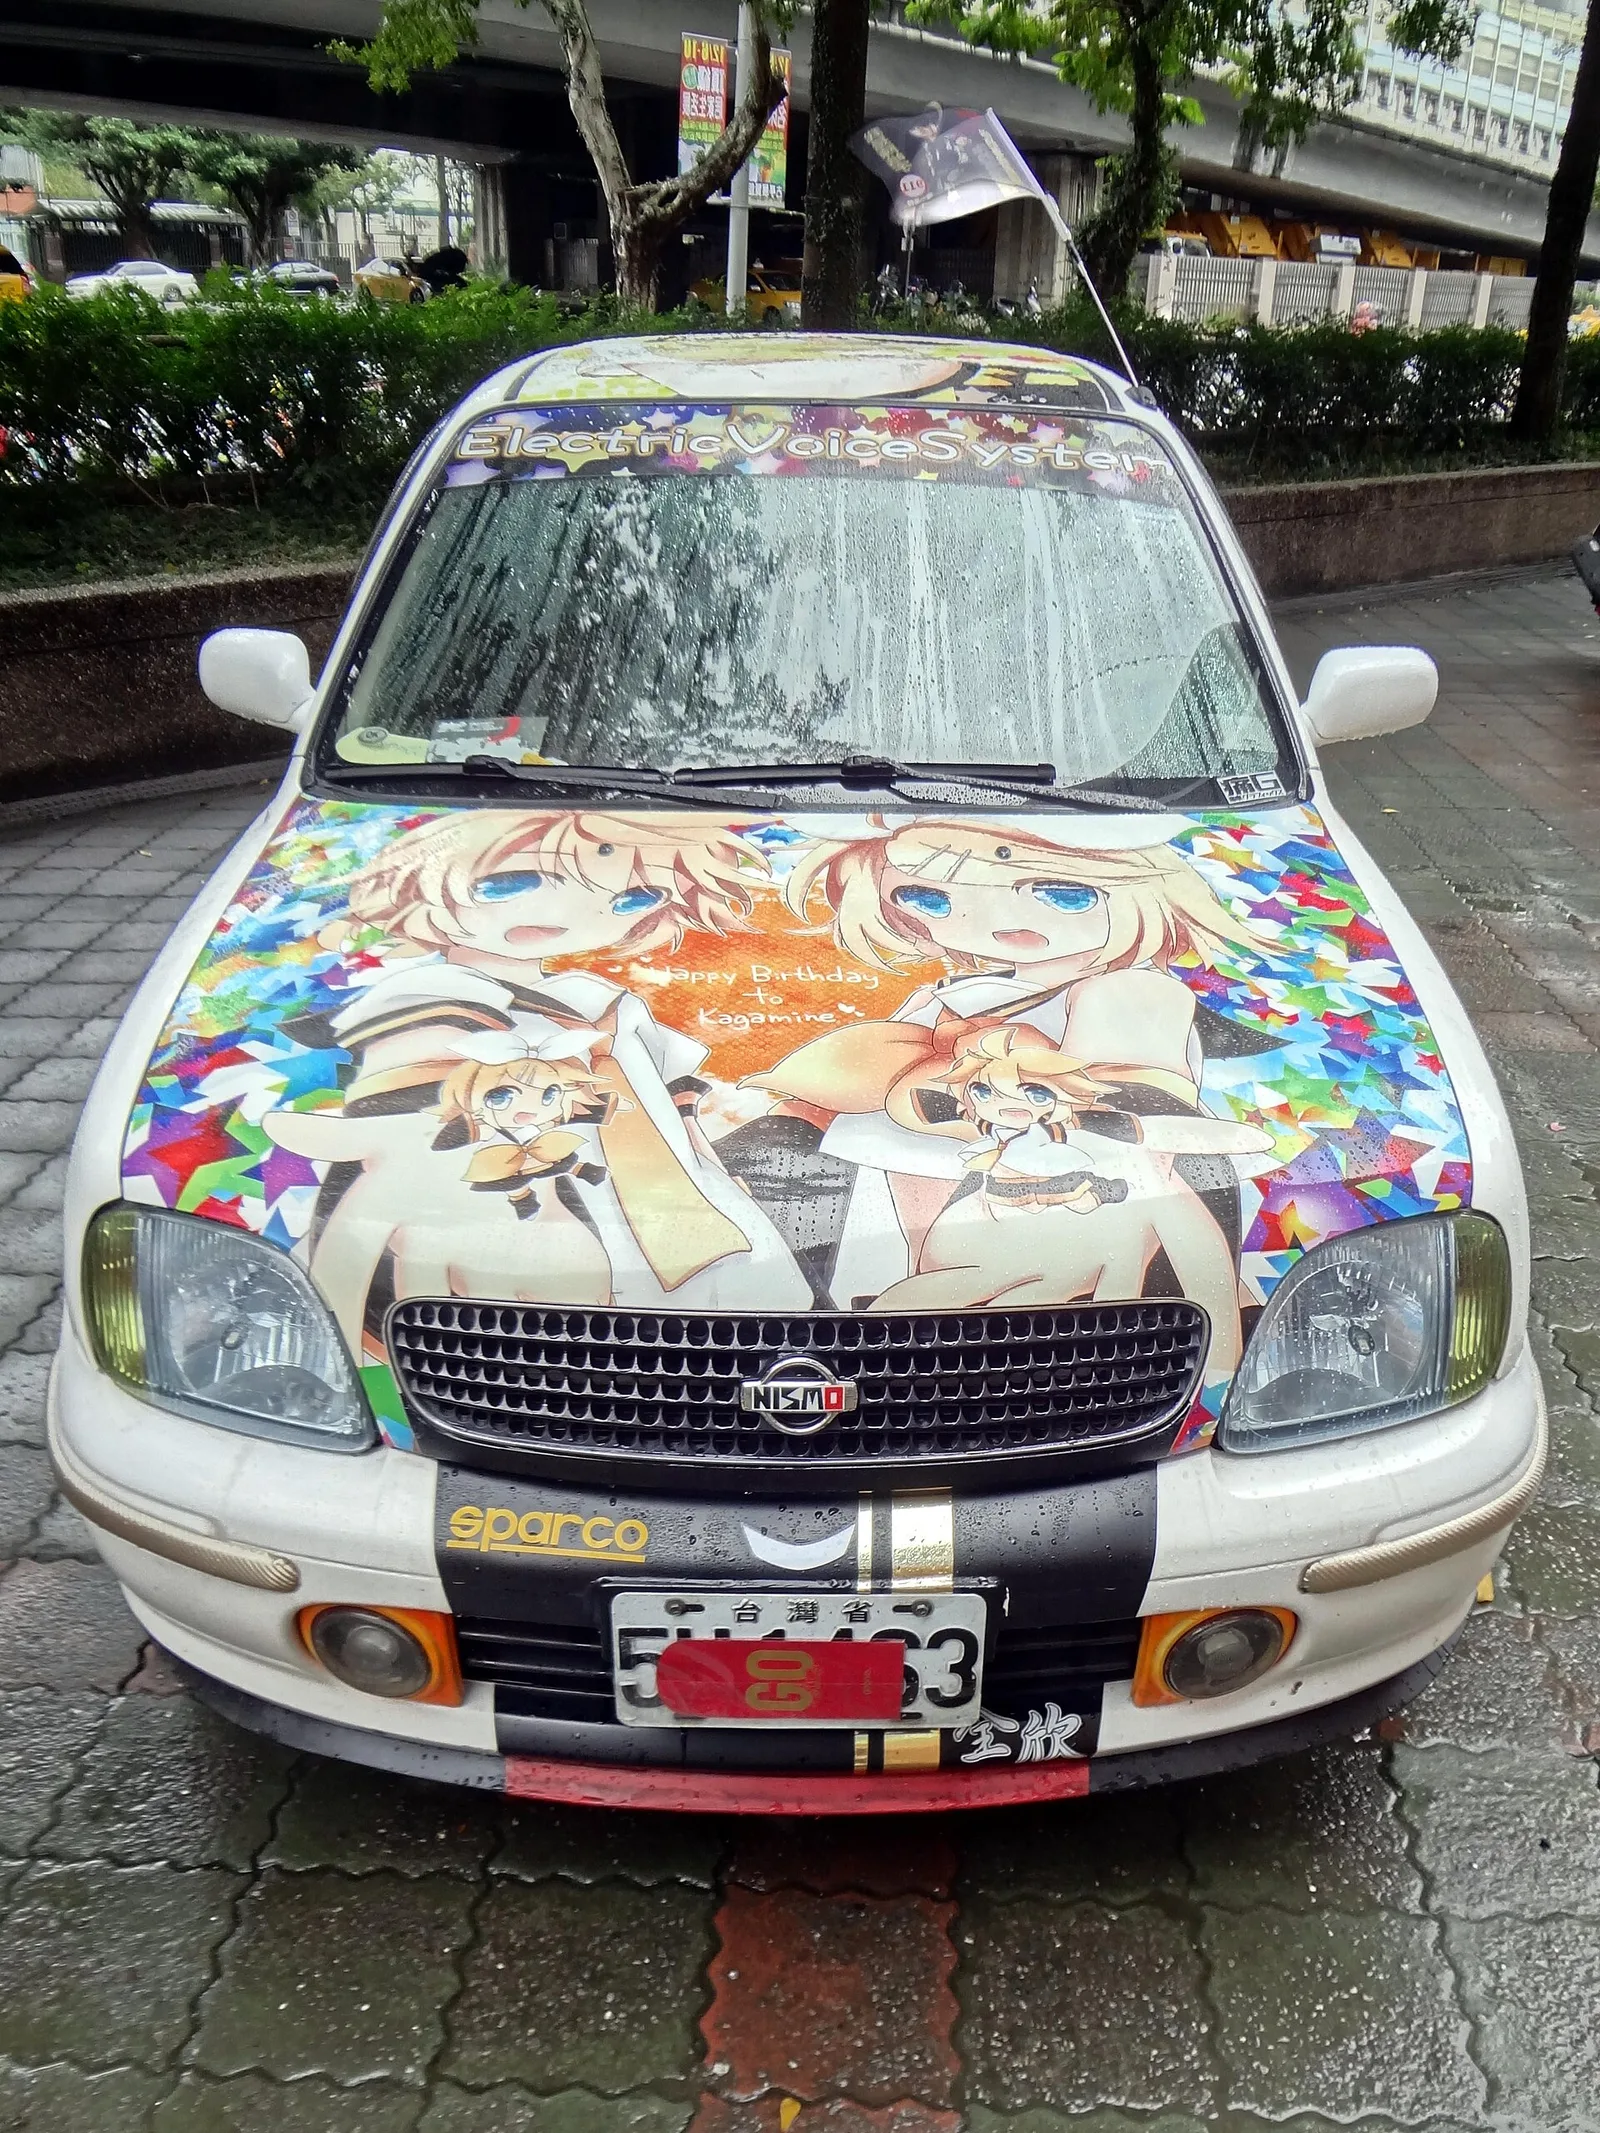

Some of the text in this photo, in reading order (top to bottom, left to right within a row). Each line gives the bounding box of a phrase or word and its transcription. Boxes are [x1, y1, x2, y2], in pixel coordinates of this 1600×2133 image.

[457, 422, 1176, 477] ElectricVoiceSystem
[750, 964, 880, 989] Birthday
[742, 985, 784, 1006] to
[699, 1007, 837, 1031] Kagamine
[752, 1385, 844, 1411] NISMO
[449, 1505, 649, 1552] sparco
[731, 1597, 874, 1625] 台灣省
